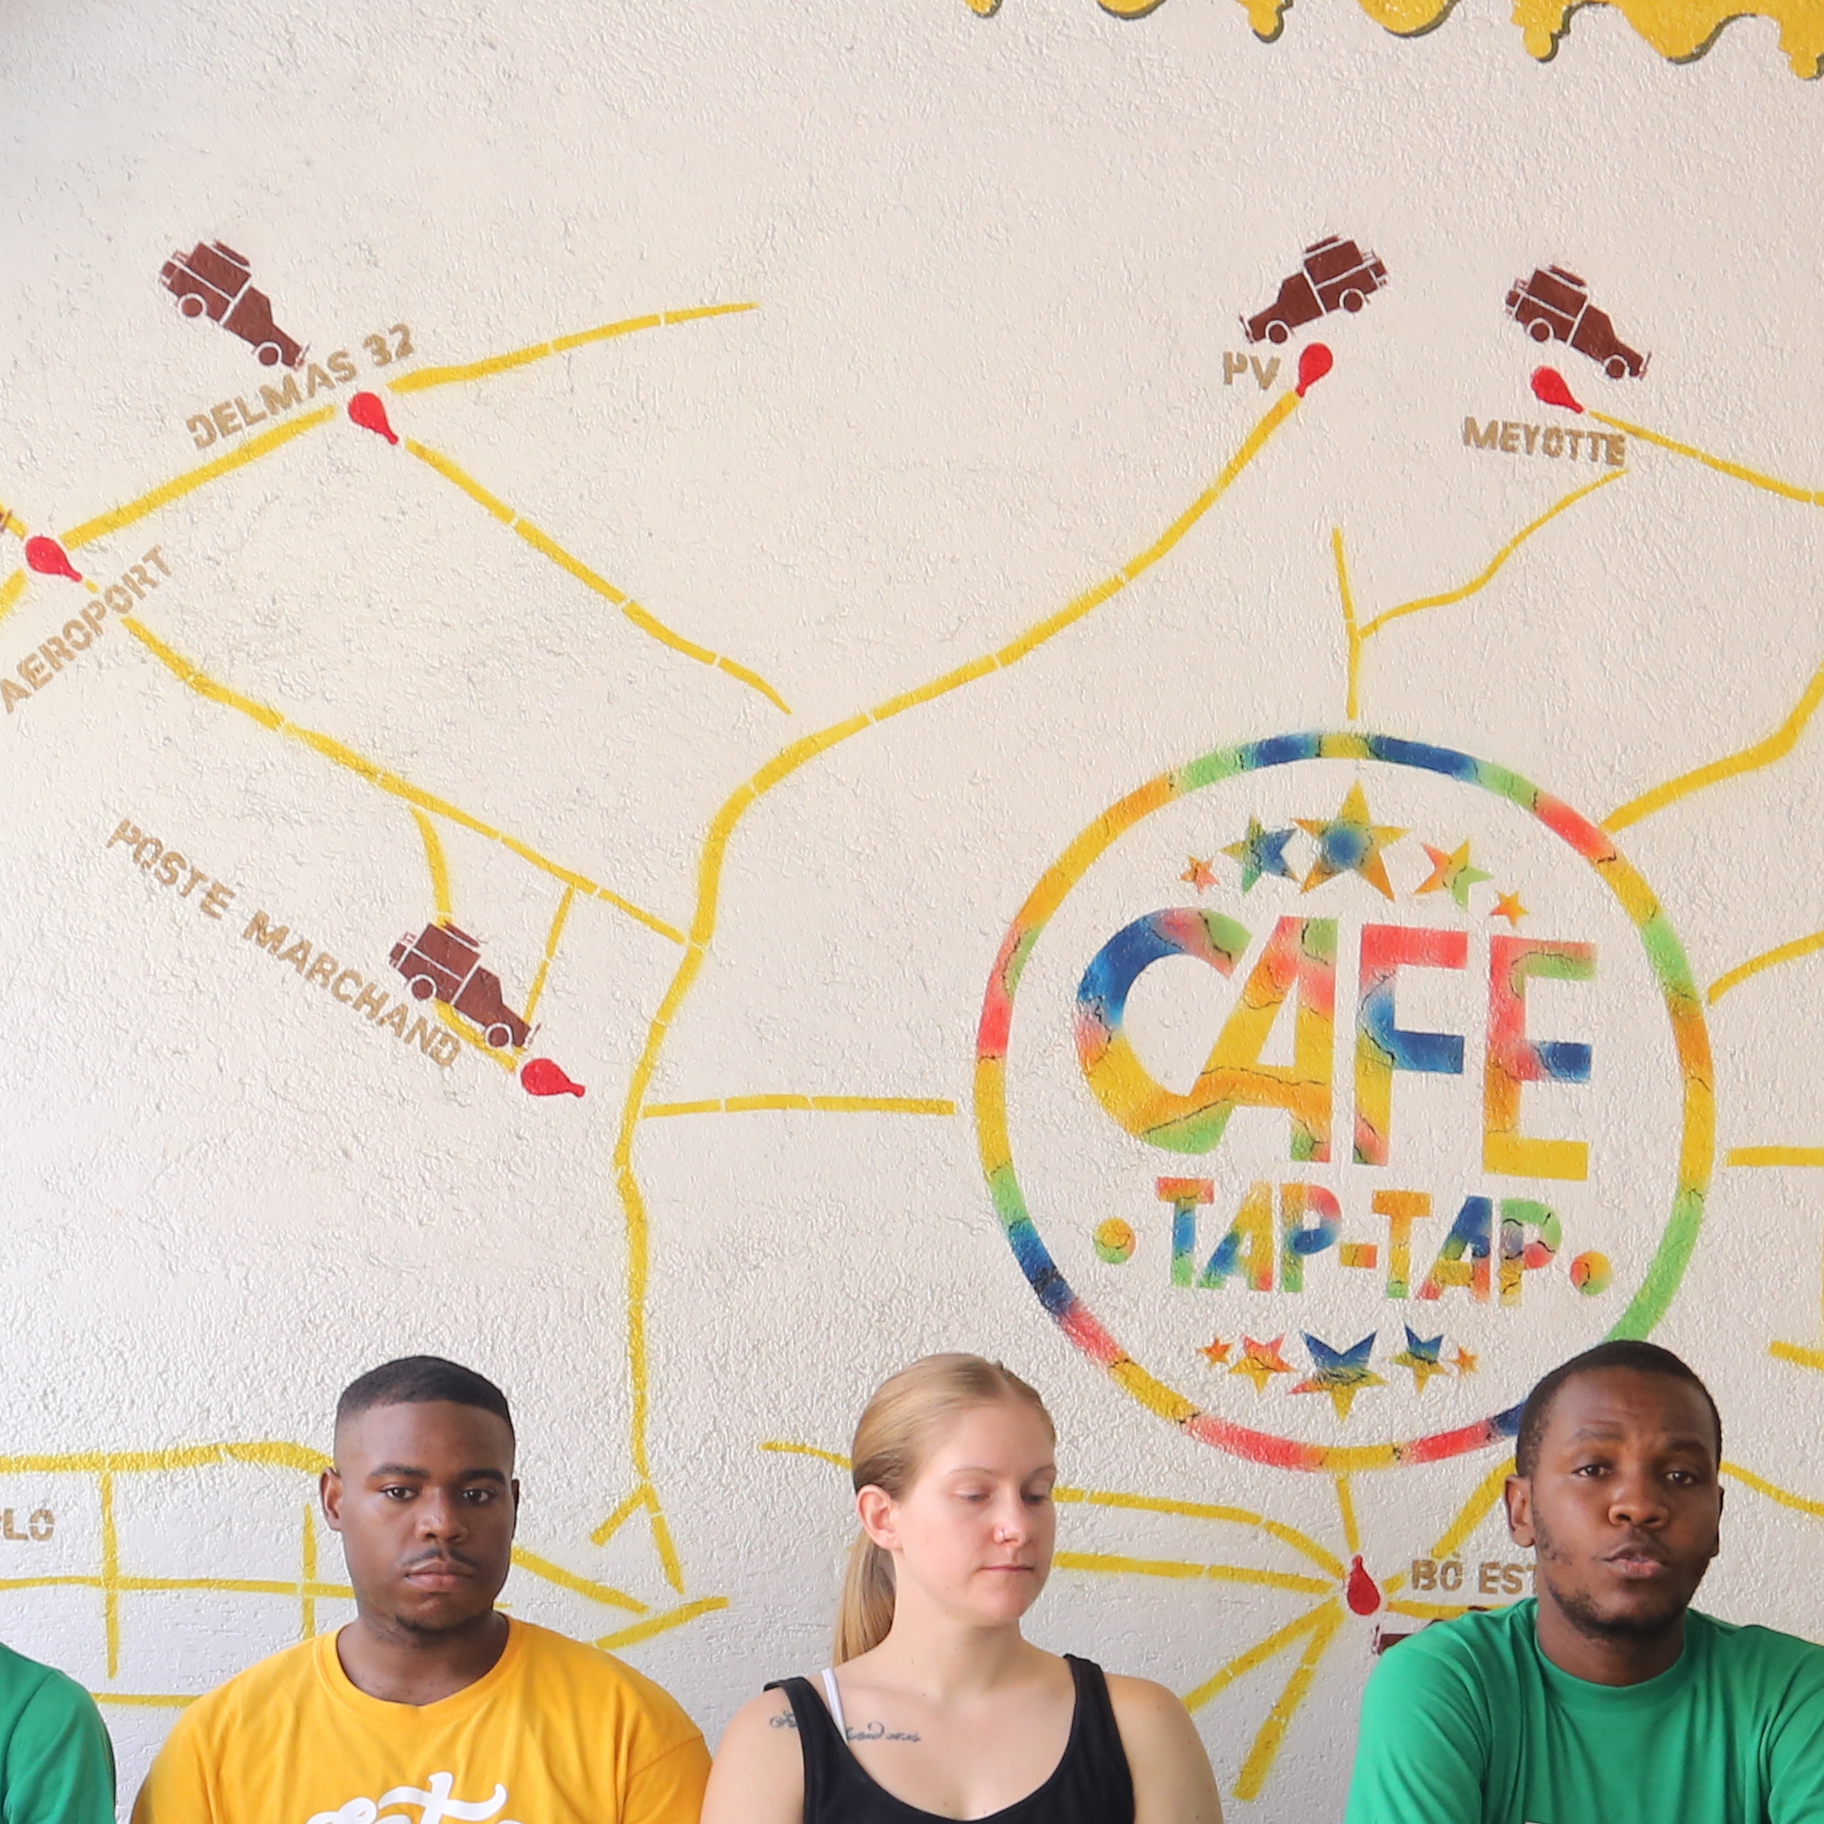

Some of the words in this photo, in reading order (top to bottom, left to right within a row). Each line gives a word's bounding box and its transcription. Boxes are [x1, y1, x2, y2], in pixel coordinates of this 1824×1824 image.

[186, 350, 357, 450] DELMAS
[364, 323, 416, 367] 32
[1222, 350, 1282, 390] PV
[1463, 416, 1626, 466] MEYOTTE
[0, 544, 175, 716] AEROPORT
[106, 818, 237, 920] POSTE
[243, 909, 463, 1070] MARCHAND
[1075, 906, 1599, 1182] CAFE
[1155, 1176, 1563, 1307] TAP-TAP
